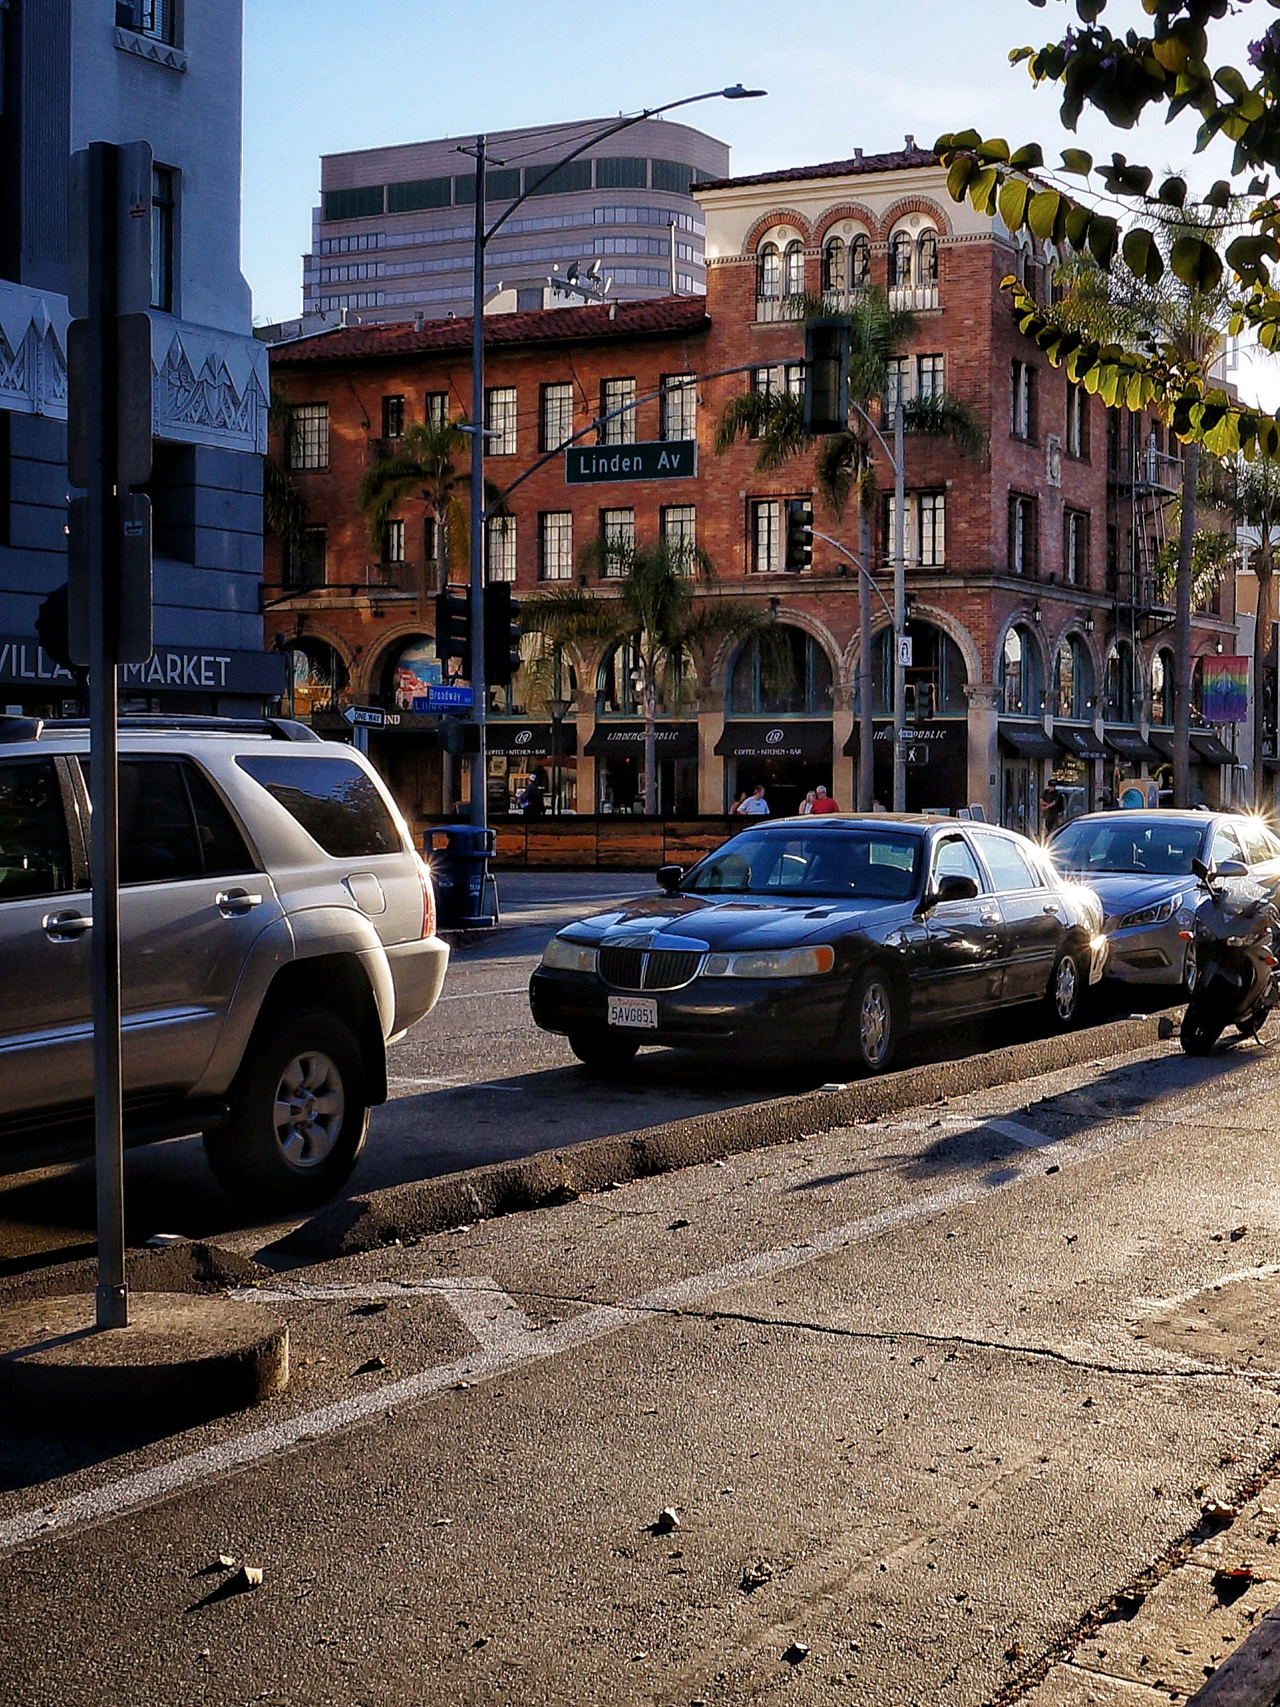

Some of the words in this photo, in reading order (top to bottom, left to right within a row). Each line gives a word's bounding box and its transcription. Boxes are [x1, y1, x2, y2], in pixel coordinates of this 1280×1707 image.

[579, 453, 643, 474] Linden
[657, 450, 681, 469] Av
[0, 644, 80, 682] ILLA
[123, 652, 231, 687] MARKET
[430, 688, 461, 703] Broadway
[354, 711, 367, 720] ONE
[368, 713, 381, 722] WAY
[734, 748, 756, 756] COFFEE
[761, 748, 785, 756] KITCHEN
[789, 748, 802, 756] BAR
[612, 1007, 654, 1023] 5AVG851
